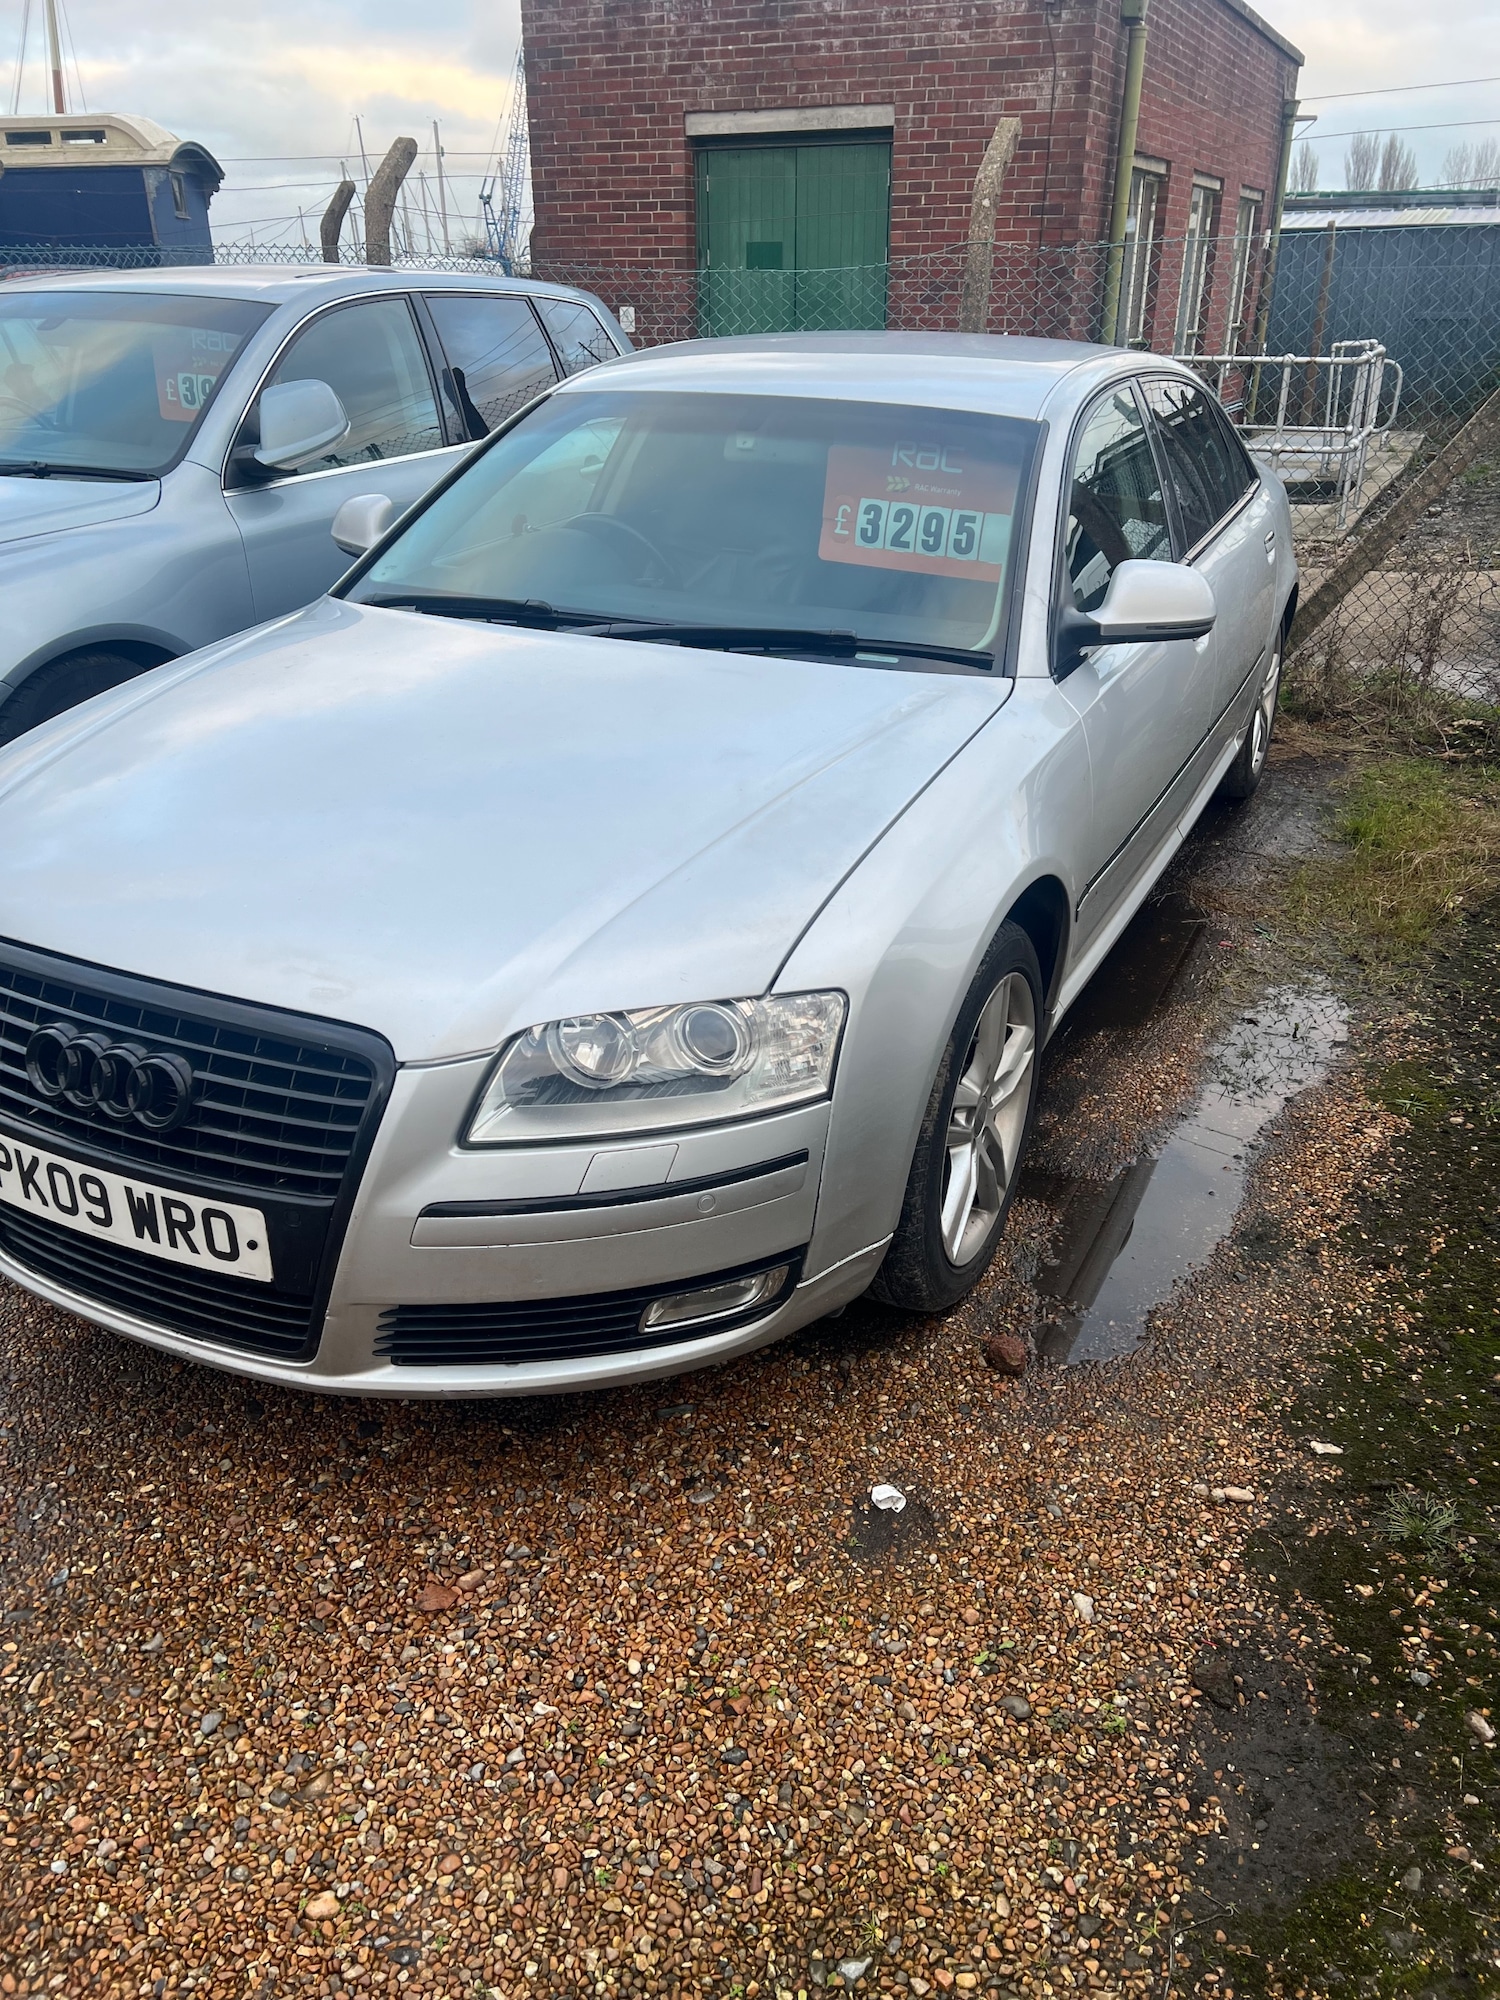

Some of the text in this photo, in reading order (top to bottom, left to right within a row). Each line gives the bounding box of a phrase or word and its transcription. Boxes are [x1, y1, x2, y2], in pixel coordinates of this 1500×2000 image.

[914, 483, 962, 497] RAC Warranty
[0, 1142, 240, 1262] PK09 WRO
